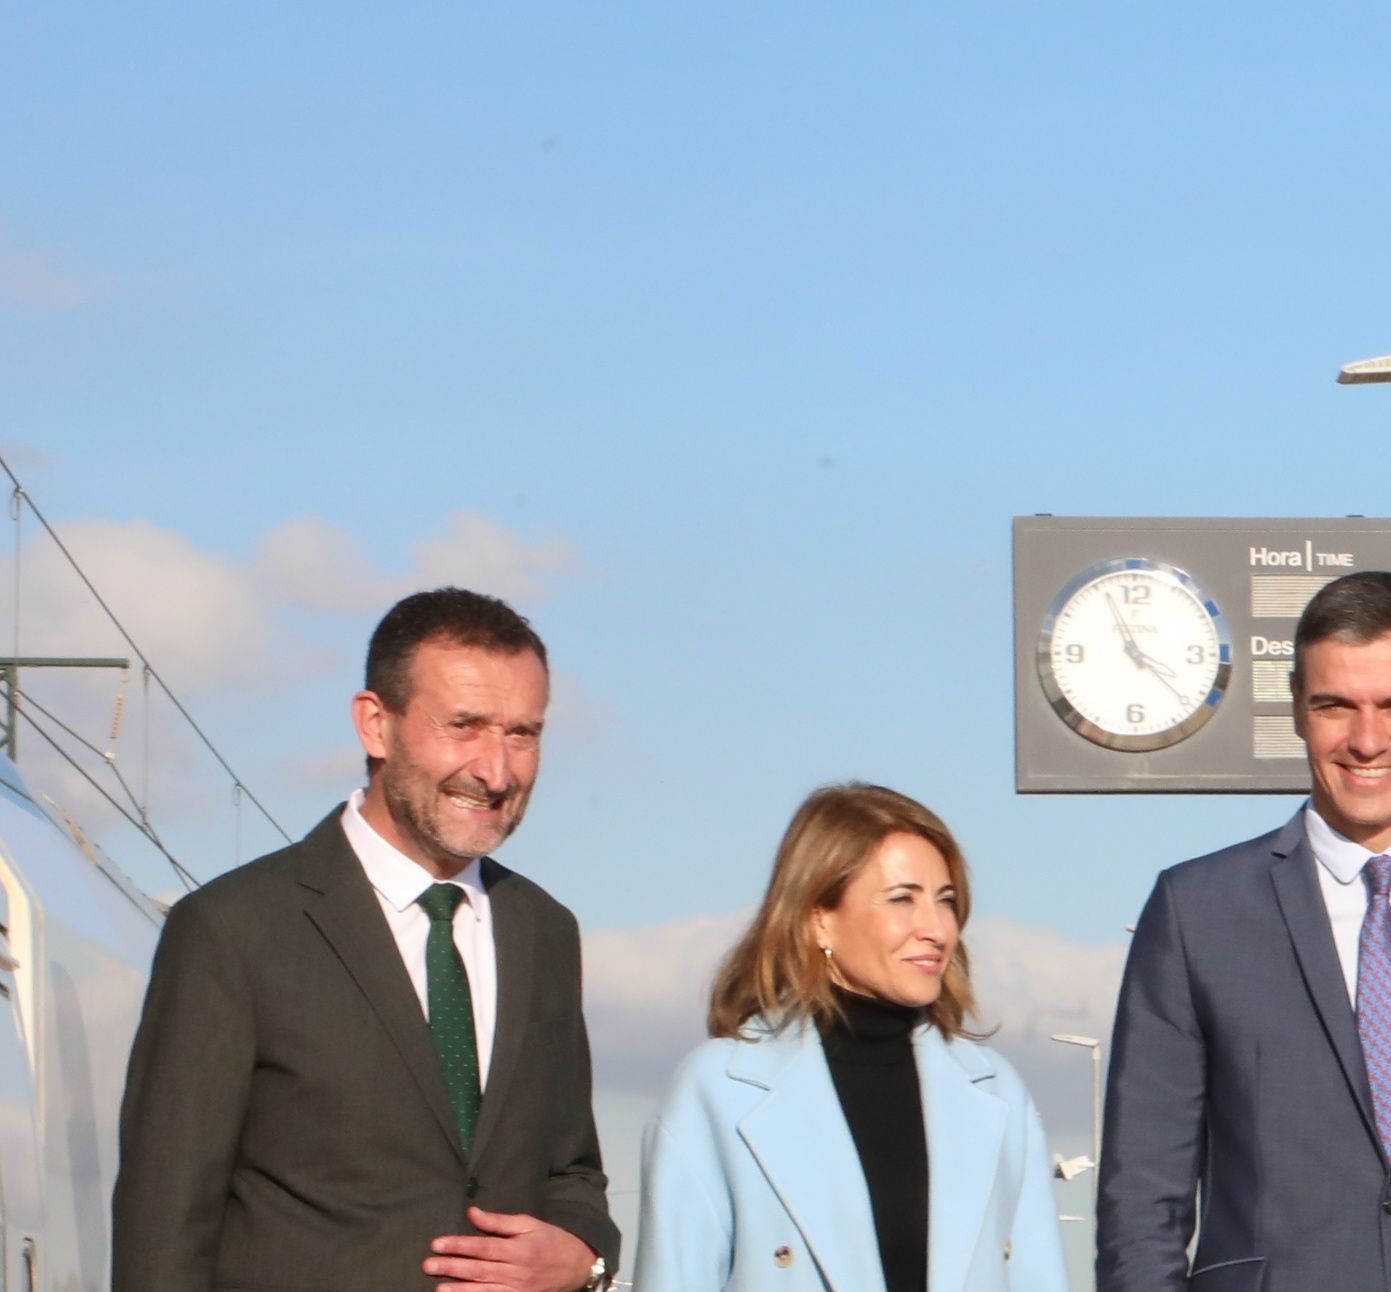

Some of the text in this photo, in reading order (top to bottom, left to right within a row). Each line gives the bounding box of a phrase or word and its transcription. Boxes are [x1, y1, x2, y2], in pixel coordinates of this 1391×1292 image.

[1249, 546, 1354, 567] Hora TIME
[1119, 584, 1152, 605] 12
[1064, 643, 1085, 664] 9
[1185, 644, 1206, 665] 3
[1125, 703, 1146, 724] 6
